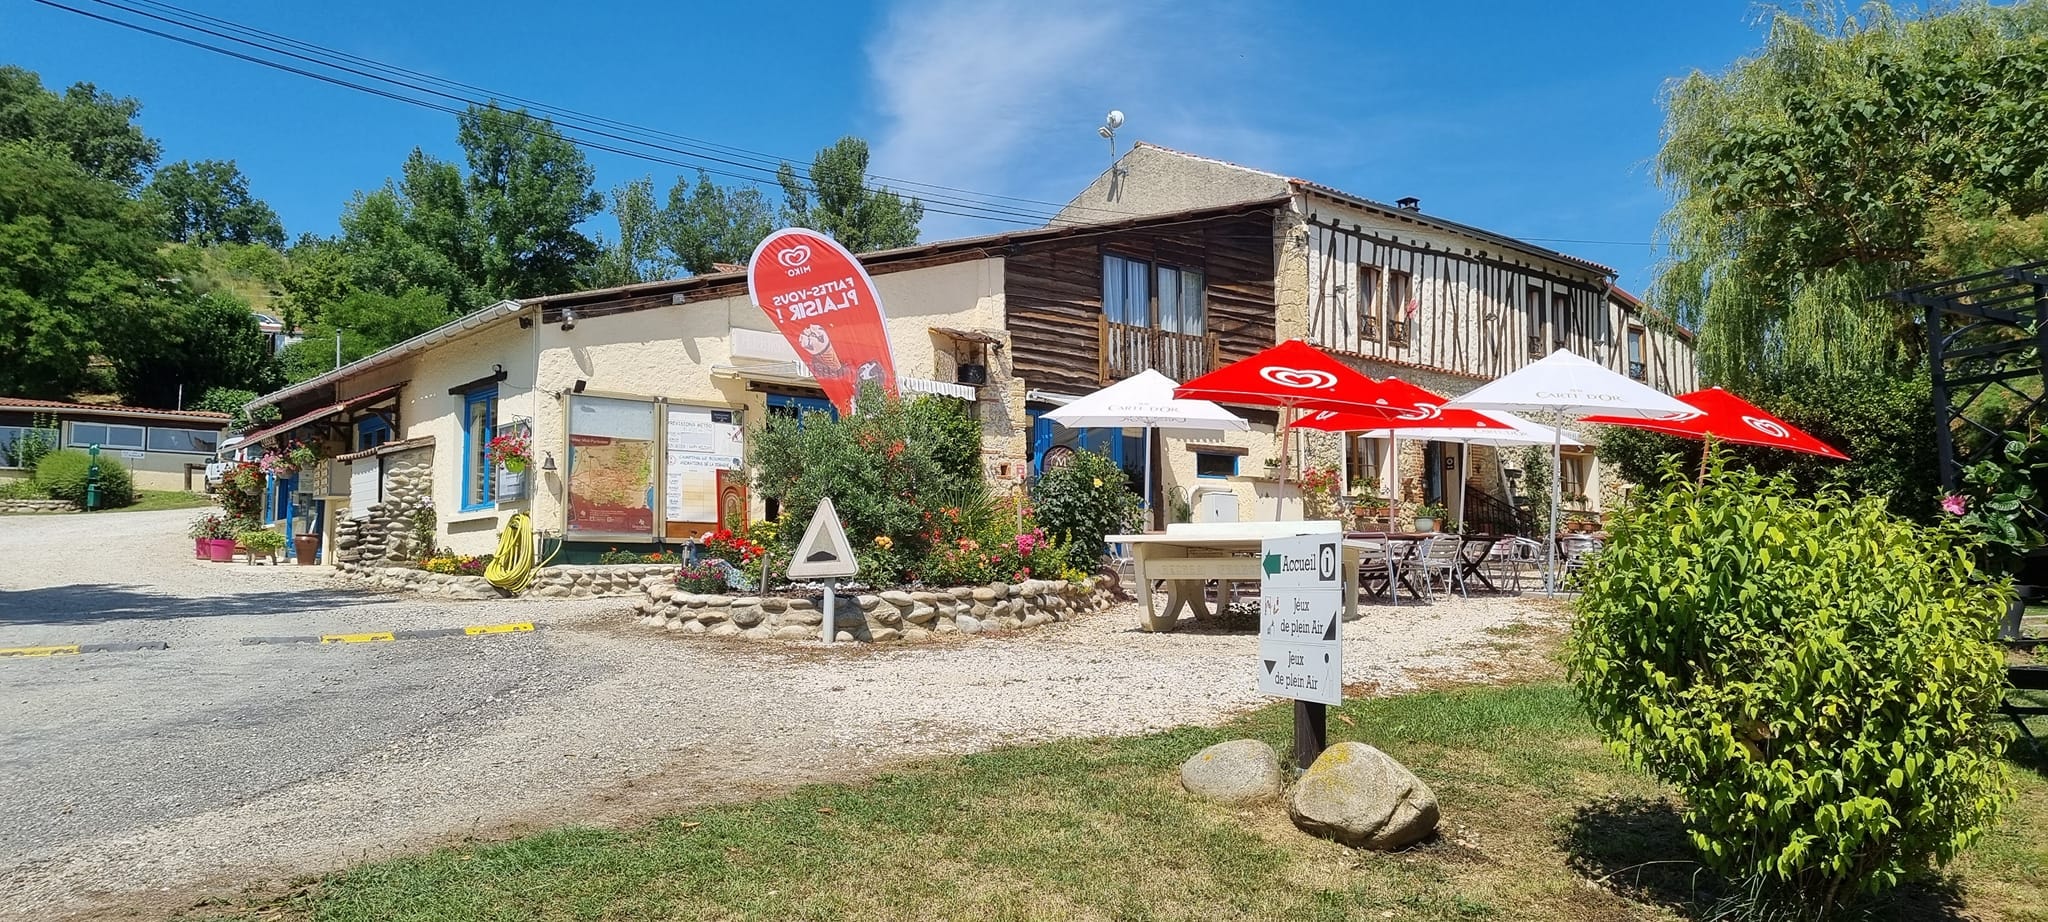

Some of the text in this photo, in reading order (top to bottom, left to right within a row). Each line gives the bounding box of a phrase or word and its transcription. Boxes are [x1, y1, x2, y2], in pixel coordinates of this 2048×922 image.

[1282, 553, 1316, 572] Accueil
[1293, 597, 1310, 615] Jeux
[1280, 618, 1323, 636] de plein Air
[1287, 650, 1304, 668] Jeux
[1275, 671, 1318, 690] de plein Air
